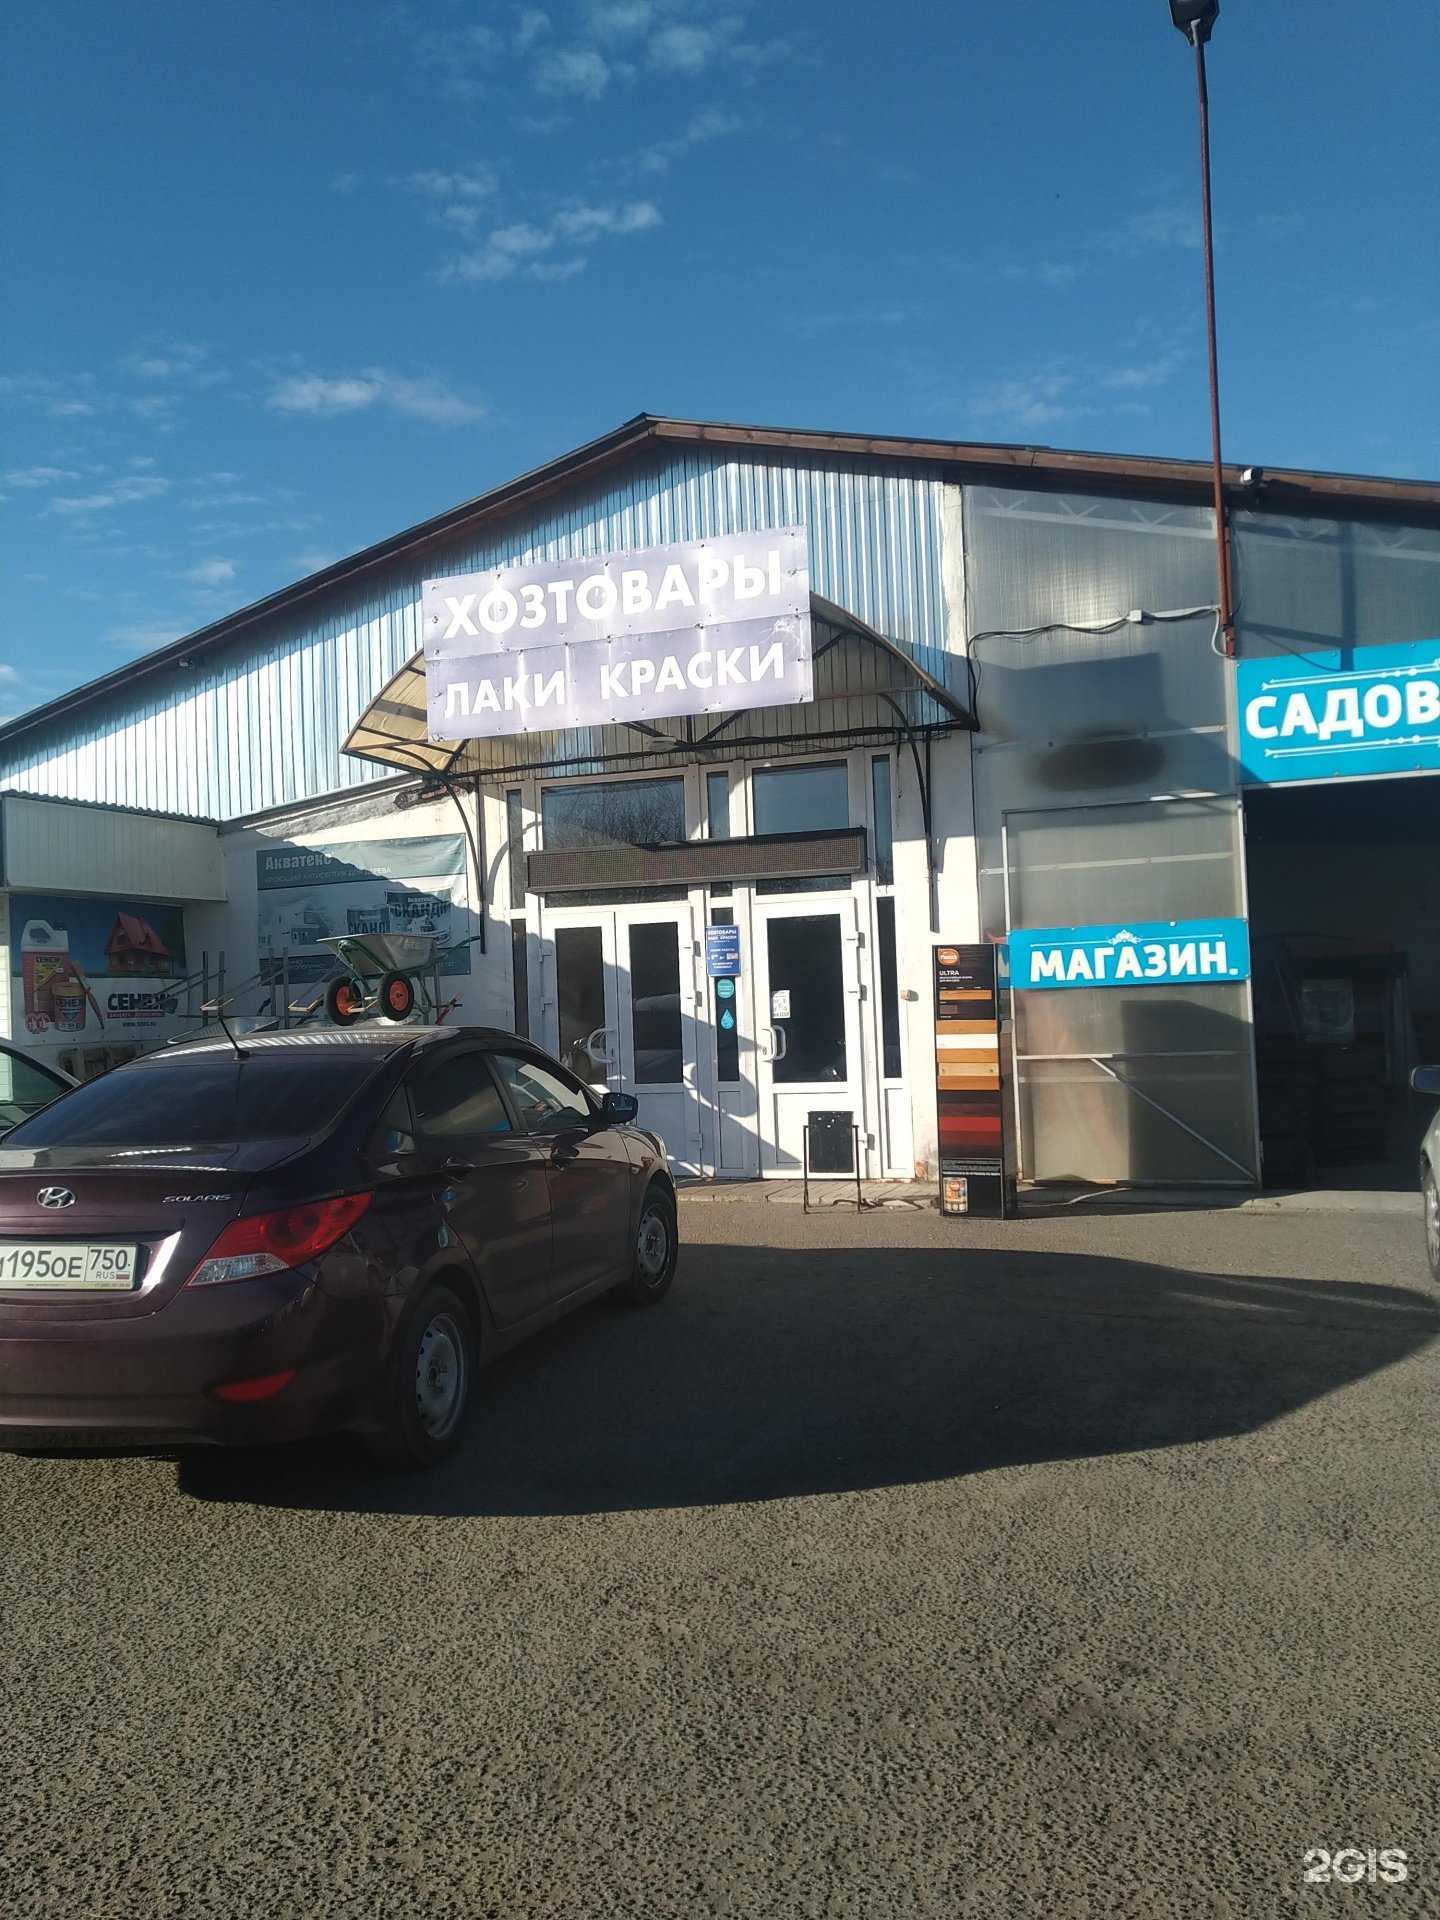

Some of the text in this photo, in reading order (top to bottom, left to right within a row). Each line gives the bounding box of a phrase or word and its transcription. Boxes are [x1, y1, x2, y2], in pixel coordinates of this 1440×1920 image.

[442, 549, 782, 640] ХОЗТОВАРЫ
[444, 642, 786, 719] ЛАКИ КРАСКИ
[1245, 680, 1440, 742] САДОВ
[1030, 940, 1239, 983] МАГАЗИН.
[162, 1193, 233, 1204] SOLARIS
[90, 1248, 128, 1271] 750
[95, 1271, 115, 1280] RUS
